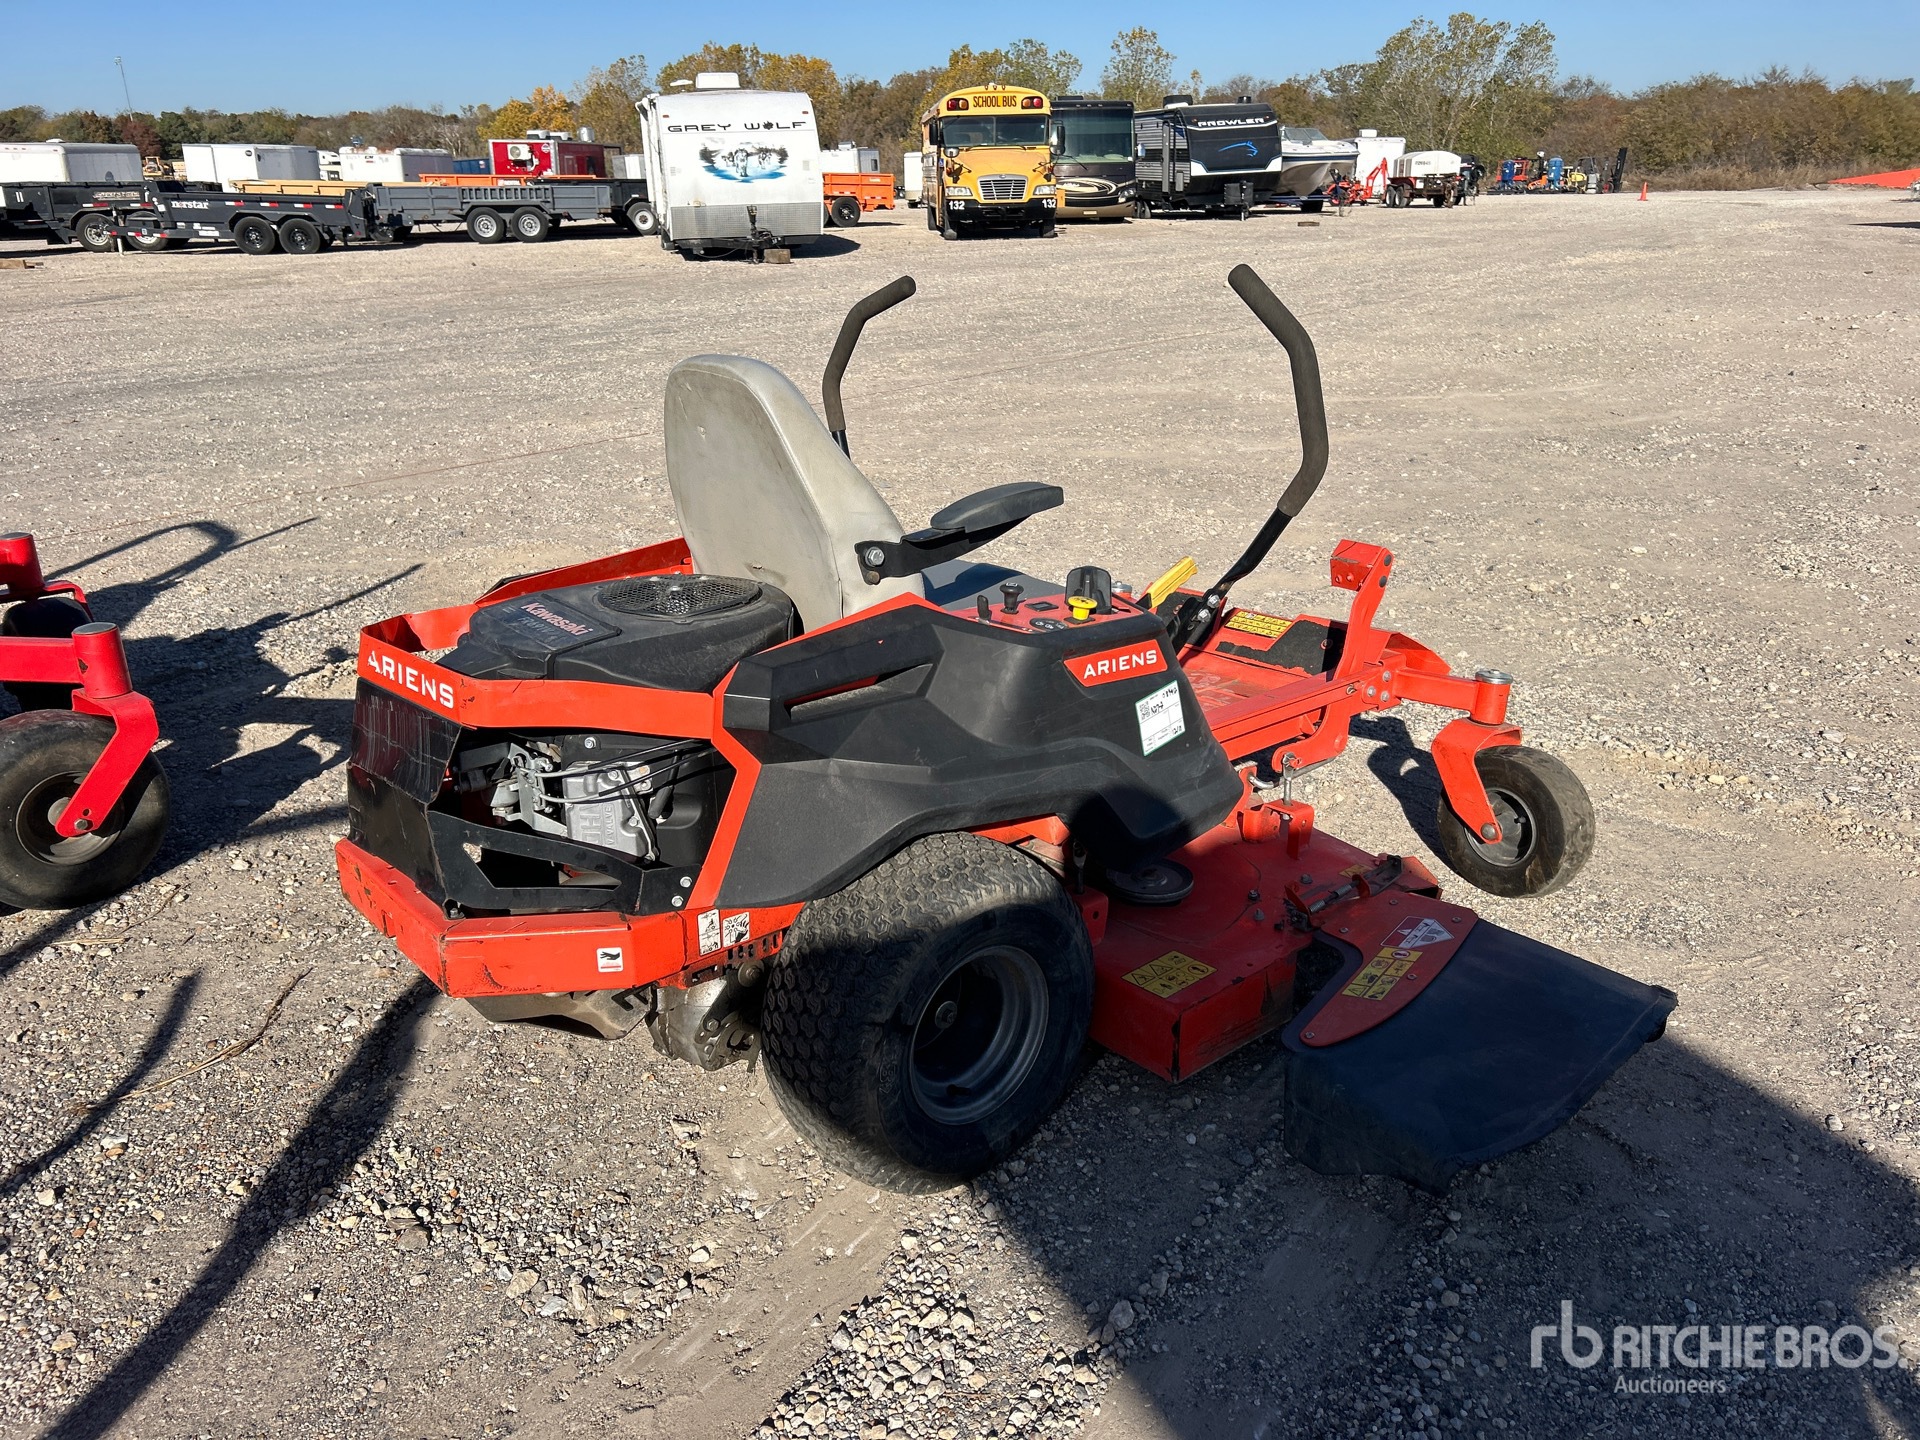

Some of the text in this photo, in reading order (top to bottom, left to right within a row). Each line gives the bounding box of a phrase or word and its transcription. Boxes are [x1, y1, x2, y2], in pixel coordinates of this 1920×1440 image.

[973, 95, 1017, 108] SCHOOL BUS
[667, 123, 732, 133] GREY
[1197, 117, 1265, 128] PROWLER
[171, 199, 209, 210] norstar
[948, 200, 965, 211] 132
[1041, 199, 1057, 209] 132
[520, 602, 594, 636] Kawasaki
[1083, 650, 1158, 680] ARIENS
[367, 650, 454, 709] ARIENS
